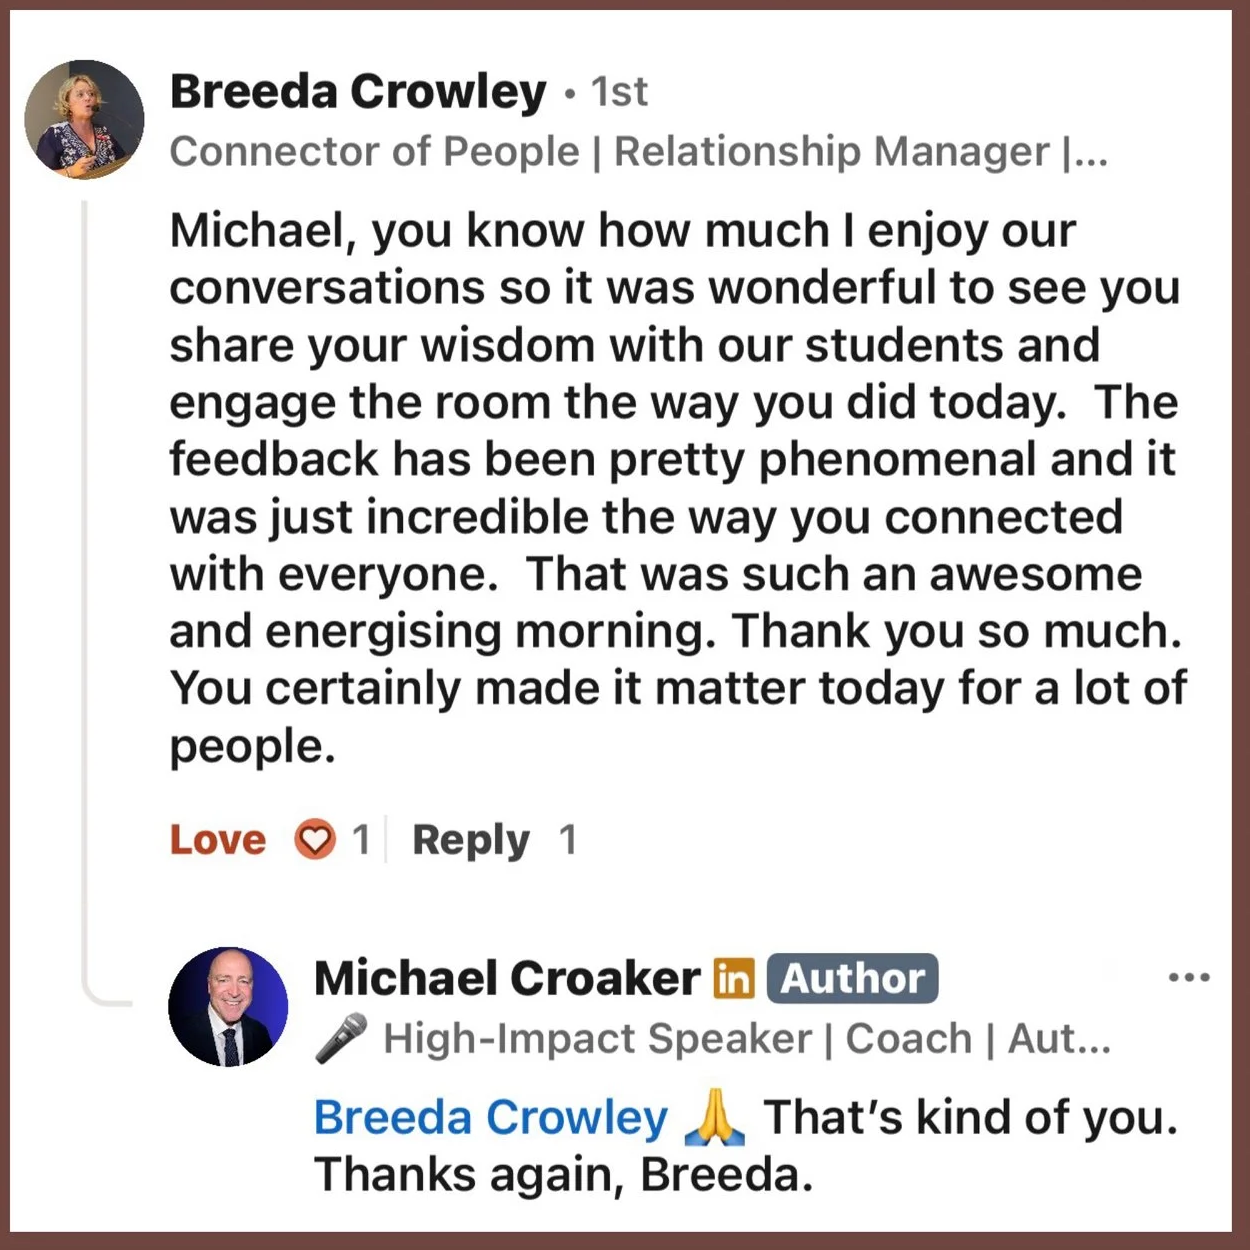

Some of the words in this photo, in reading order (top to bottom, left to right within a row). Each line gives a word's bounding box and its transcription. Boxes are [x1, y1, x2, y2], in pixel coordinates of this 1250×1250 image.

[172, 71, 337, 109] Breeda
[351, 71, 547, 117] Crowley
[592, 75, 648, 107] 1st
[170, 135, 380, 167] Connector
[393, 134, 432, 166] of
[445, 134, 579, 174] People
[616, 133, 861, 174] Relationship
[876, 135, 1051, 174] Manager
[172, 209, 355, 256] Michael,
[371, 220, 450, 256] you
[468, 210, 585, 248] know
[600, 210, 691, 248] how
[707, 210, 828, 248] much
[845, 212, 852, 247] I
[868, 209, 989, 256] enjoy
[1002, 220, 1077, 248] our
[170, 266, 484, 305] conversations
[500, 277, 550, 305] so
[566, 266, 592, 304] it
[606, 277, 694, 305] was
[708, 267, 935, 305] wonderful
[949, 271, 994, 305] to
[1009, 277, 1086, 305] see
[1100, 277, 1179, 313] you
[170, 325, 294, 363] share
[308, 335, 407, 371] your
[420, 324, 594, 362] wisdom
[609, 324, 703, 362] with
[718, 335, 793, 363] our
[806, 325, 1003, 363] students
[1018, 325, 1099, 362] and
[170, 392, 336, 428] engage
[349, 382, 422, 419] the
[437, 392, 550, 419] room
[564, 382, 636, 419] the
[650, 392, 739, 428] way
[753, 392, 832, 428] you
[847, 381, 915, 419] did
[929, 382, 1066, 428] today.
[1094, 382, 1178, 419] The
[169, 439, 379, 476] feedback
[394, 439, 470, 476] has
[486, 439, 594, 476] been
[611, 443, 745, 485] pretty
[761, 439, 1035, 485] phenomenal
[1051, 439, 1132, 476] and
[1148, 438, 1176, 476] it
[170, 507, 257, 534] was
[268, 496, 353, 543] just
[368, 496, 588, 534] incredible
[602, 497, 674, 534] the
[688, 507, 777, 543] way
[790, 507, 869, 543] you
[885, 497, 1122, 534] connected
[170, 553, 263, 591] with
[279, 564, 497, 600] everyone.
[526, 554, 626, 591] That
[640, 563, 728, 591] was
[743, 554, 848, 591] such
[863, 564, 915, 591] an
[930, 563, 1142, 591] awesome
[170, 611, 251, 648] and
[266, 610, 500, 657] energising
[517, 610, 715, 657] morning.
[731, 611, 870, 648] Thank
[884, 621, 963, 657] you
[979, 621, 1029, 648] so
[1046, 611, 1181, 648] much.
[170, 670, 251, 705] You
[266, 667, 461, 714] certainly
[477, 668, 599, 705] made
[615, 667, 641, 705] it
[657, 672, 806, 705] matter
[818, 668, 945, 714] today
[958, 668, 1022, 705] for
[1035, 678, 1058, 705] a
[1076, 668, 1130, 705] lot
[1144, 668, 1188, 705] of
[171, 726, 334, 771] people.
[171, 824, 266, 855] Love
[353, 824, 368, 854] 1
[414, 822, 530, 863] Reply
[560, 824, 574, 854] 1
[316, 956, 496, 996] Michael
[511, 958, 702, 996] Croaker
[780, 961, 926, 994] Author
[385, 1020, 635, 1061] High-Impact
[649, 1021, 813, 1061] Speaker
[847, 1021, 971, 1054] Coach
[1008, 1022, 1110, 1054] Aut...
[316, 1098, 471, 1135] Breeda
[488, 1098, 668, 1143] Crowley
[918, 1096, 1010, 1135] kind
[1025, 1097, 1070, 1135] of
[1083, 1107, 1177, 1143] you.
[314, 1154, 475, 1192] Thanks
[491, 1153, 623, 1200] again,
[643, 1154, 812, 1192] Breeda.
